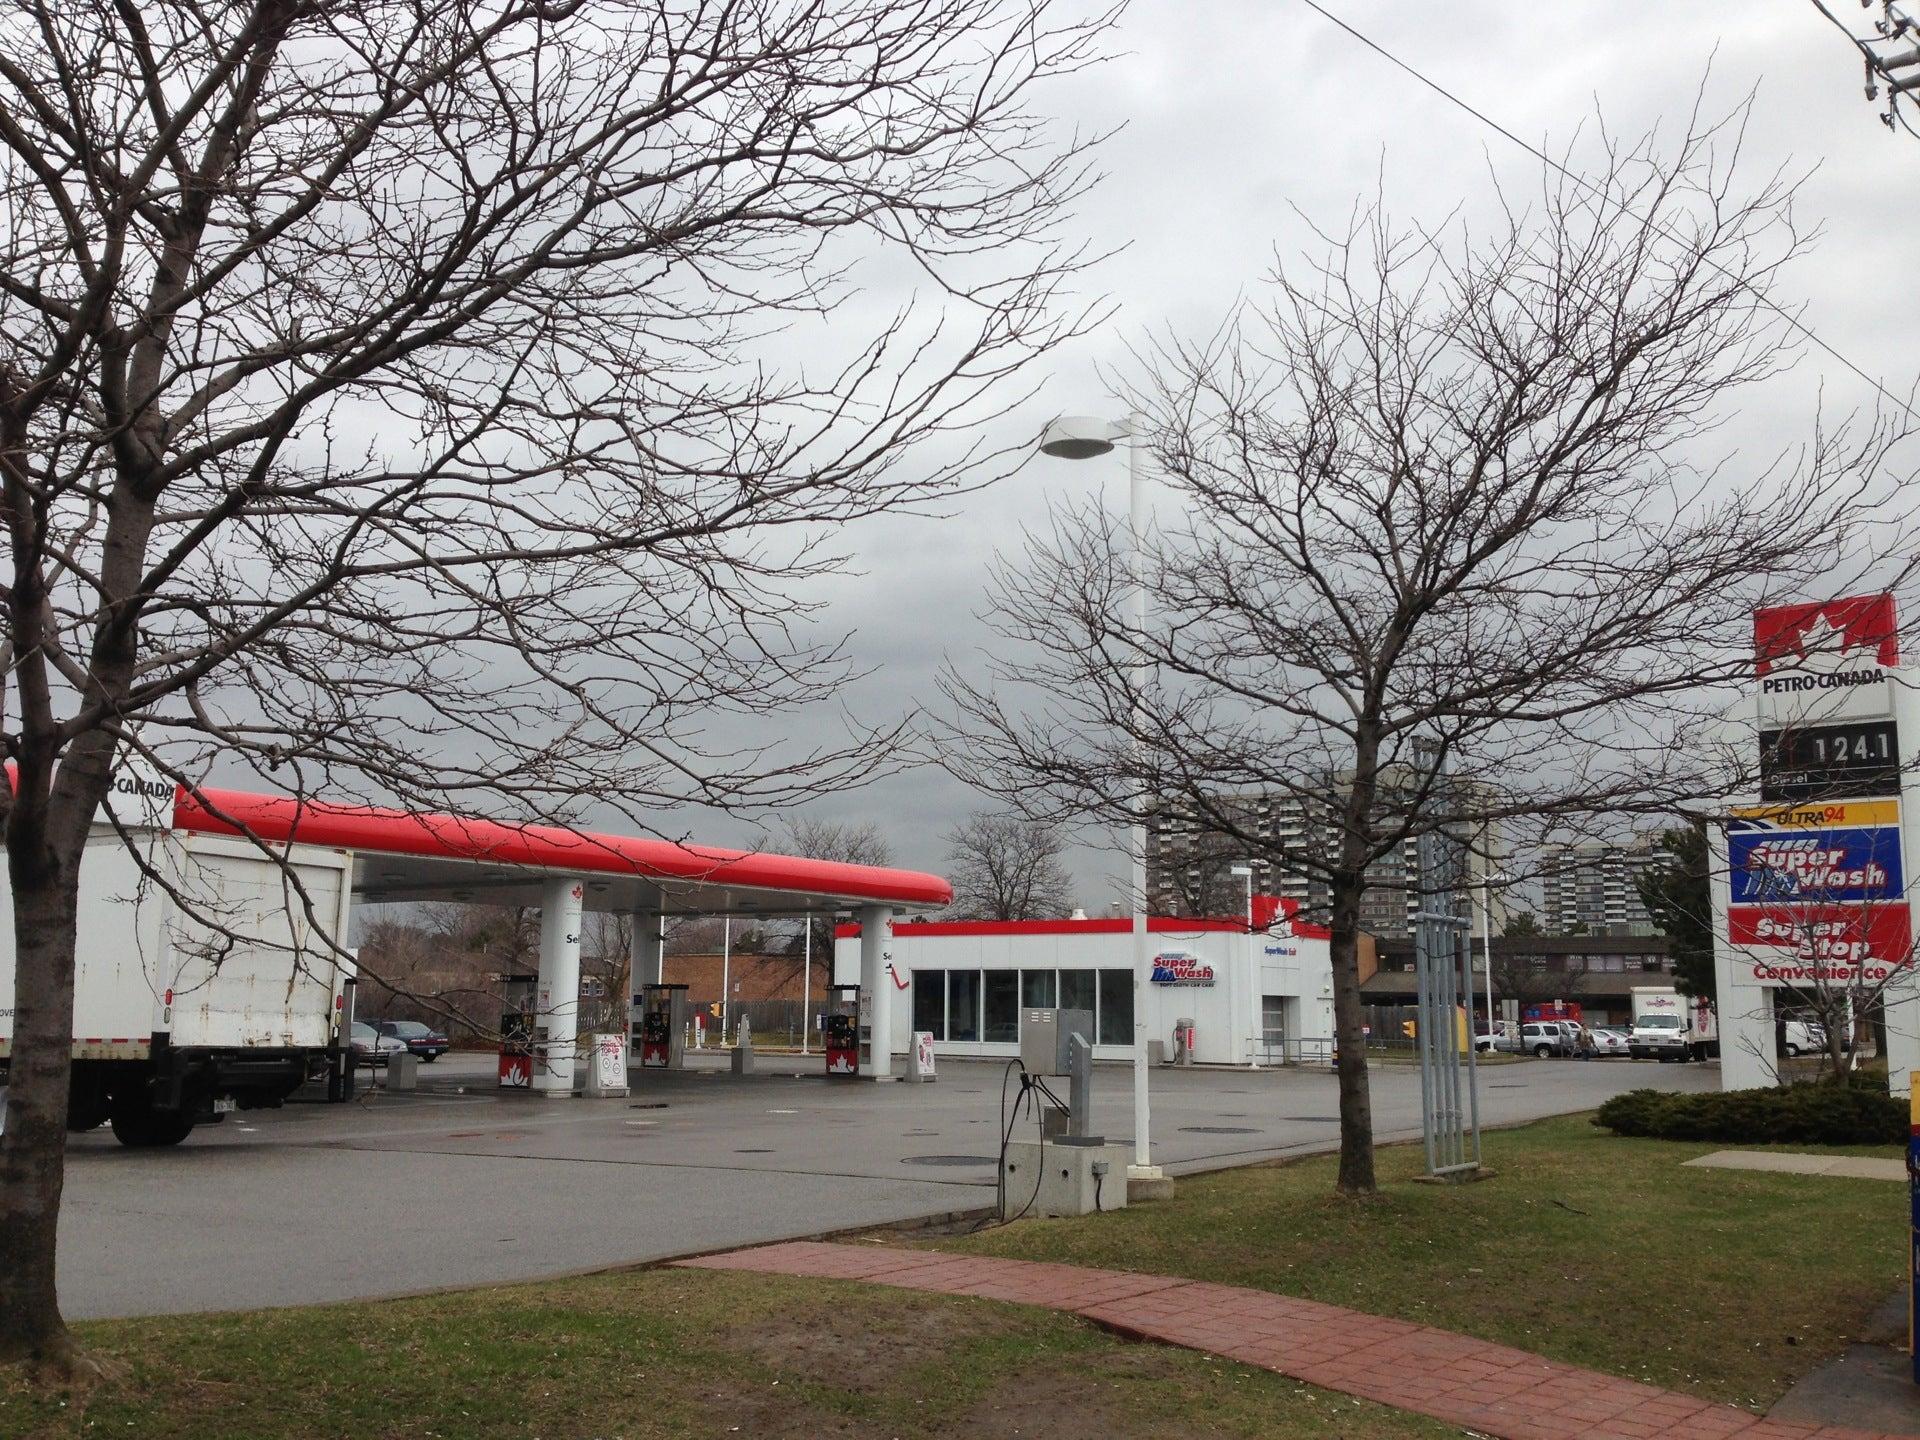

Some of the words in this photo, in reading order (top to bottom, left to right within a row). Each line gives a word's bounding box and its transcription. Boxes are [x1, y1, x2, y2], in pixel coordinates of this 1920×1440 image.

[1815, 733, 1889, 762] 124.1
[1749, 847, 1845, 871] Super
[1797, 863, 1886, 888] Wash
[1754, 918, 1847, 942] Super
[1799, 937, 1870, 961] Stop
[1153, 956, 1196, 969] Super
[1174, 966, 1213, 979] Wash
[1753, 964, 1888, 981] Convenience
